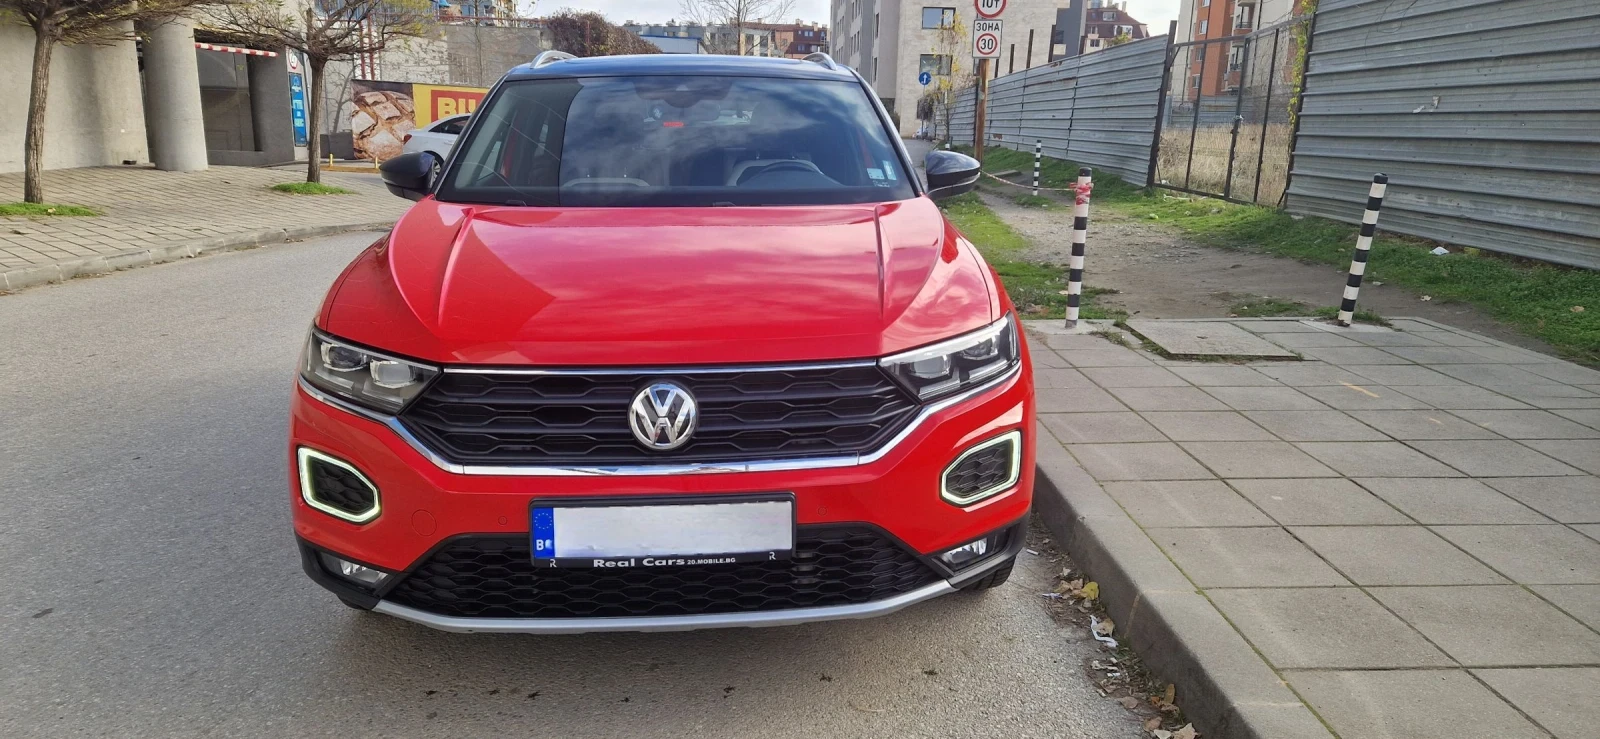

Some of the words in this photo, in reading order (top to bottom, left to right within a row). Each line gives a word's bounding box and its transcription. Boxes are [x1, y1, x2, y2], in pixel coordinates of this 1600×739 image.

[976, 22, 1000, 31] ЗОНА
[980, 38, 994, 50] 30
[593, 558, 635, 568] Real
[642, 558, 685, 567] Cars
[687, 557, 736, 565] 20.MOBILE.BG
